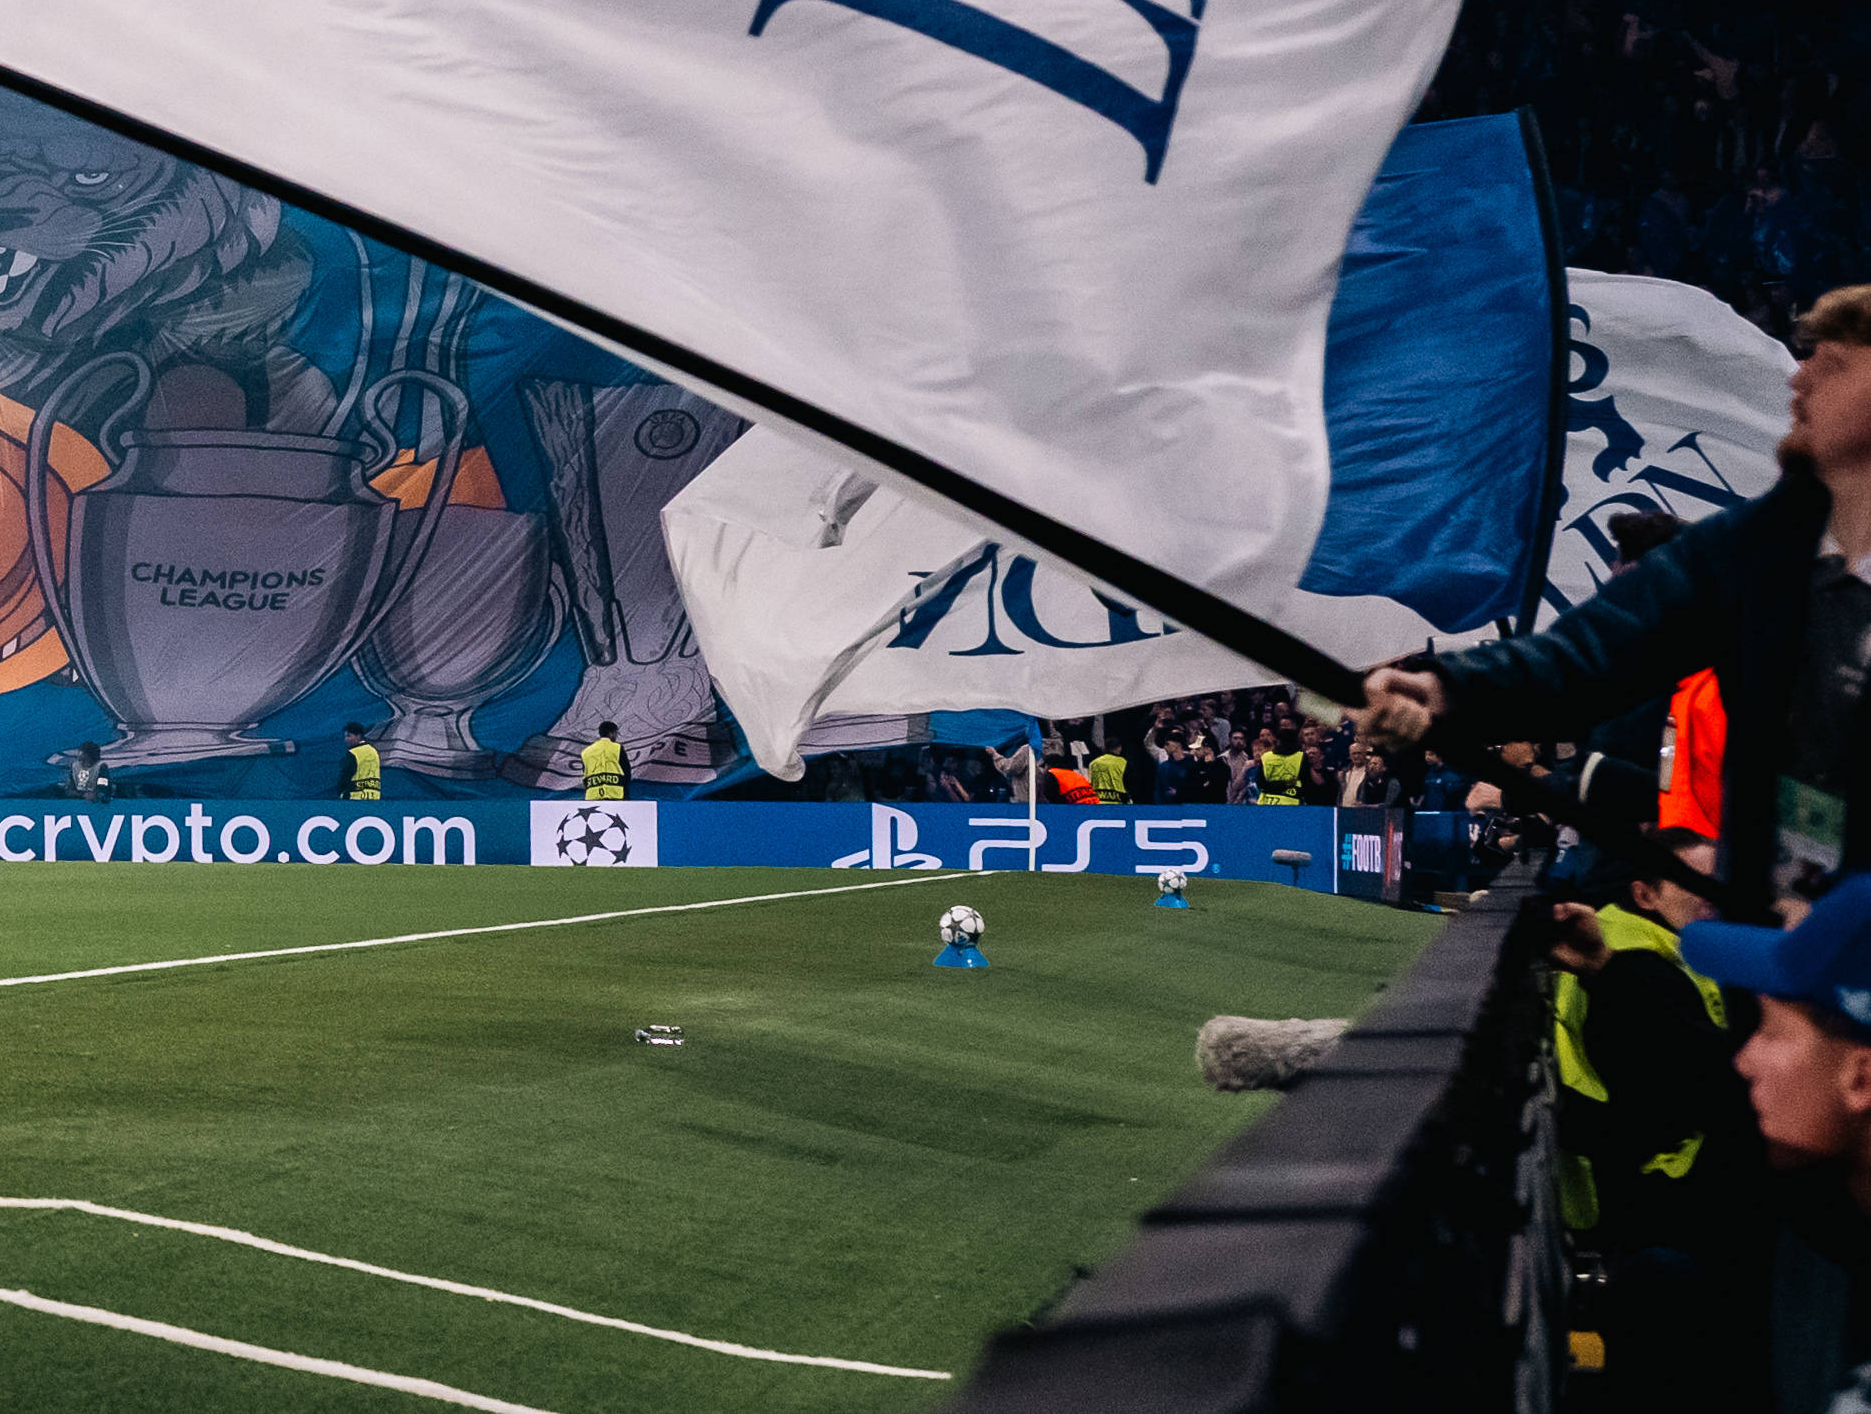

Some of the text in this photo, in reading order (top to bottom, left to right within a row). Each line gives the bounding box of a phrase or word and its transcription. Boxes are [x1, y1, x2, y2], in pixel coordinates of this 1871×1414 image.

[130, 561, 327, 589] CHAMPIONS
[160, 587, 290, 612] LEAGUE
[968, 818, 1210, 874] PS5
